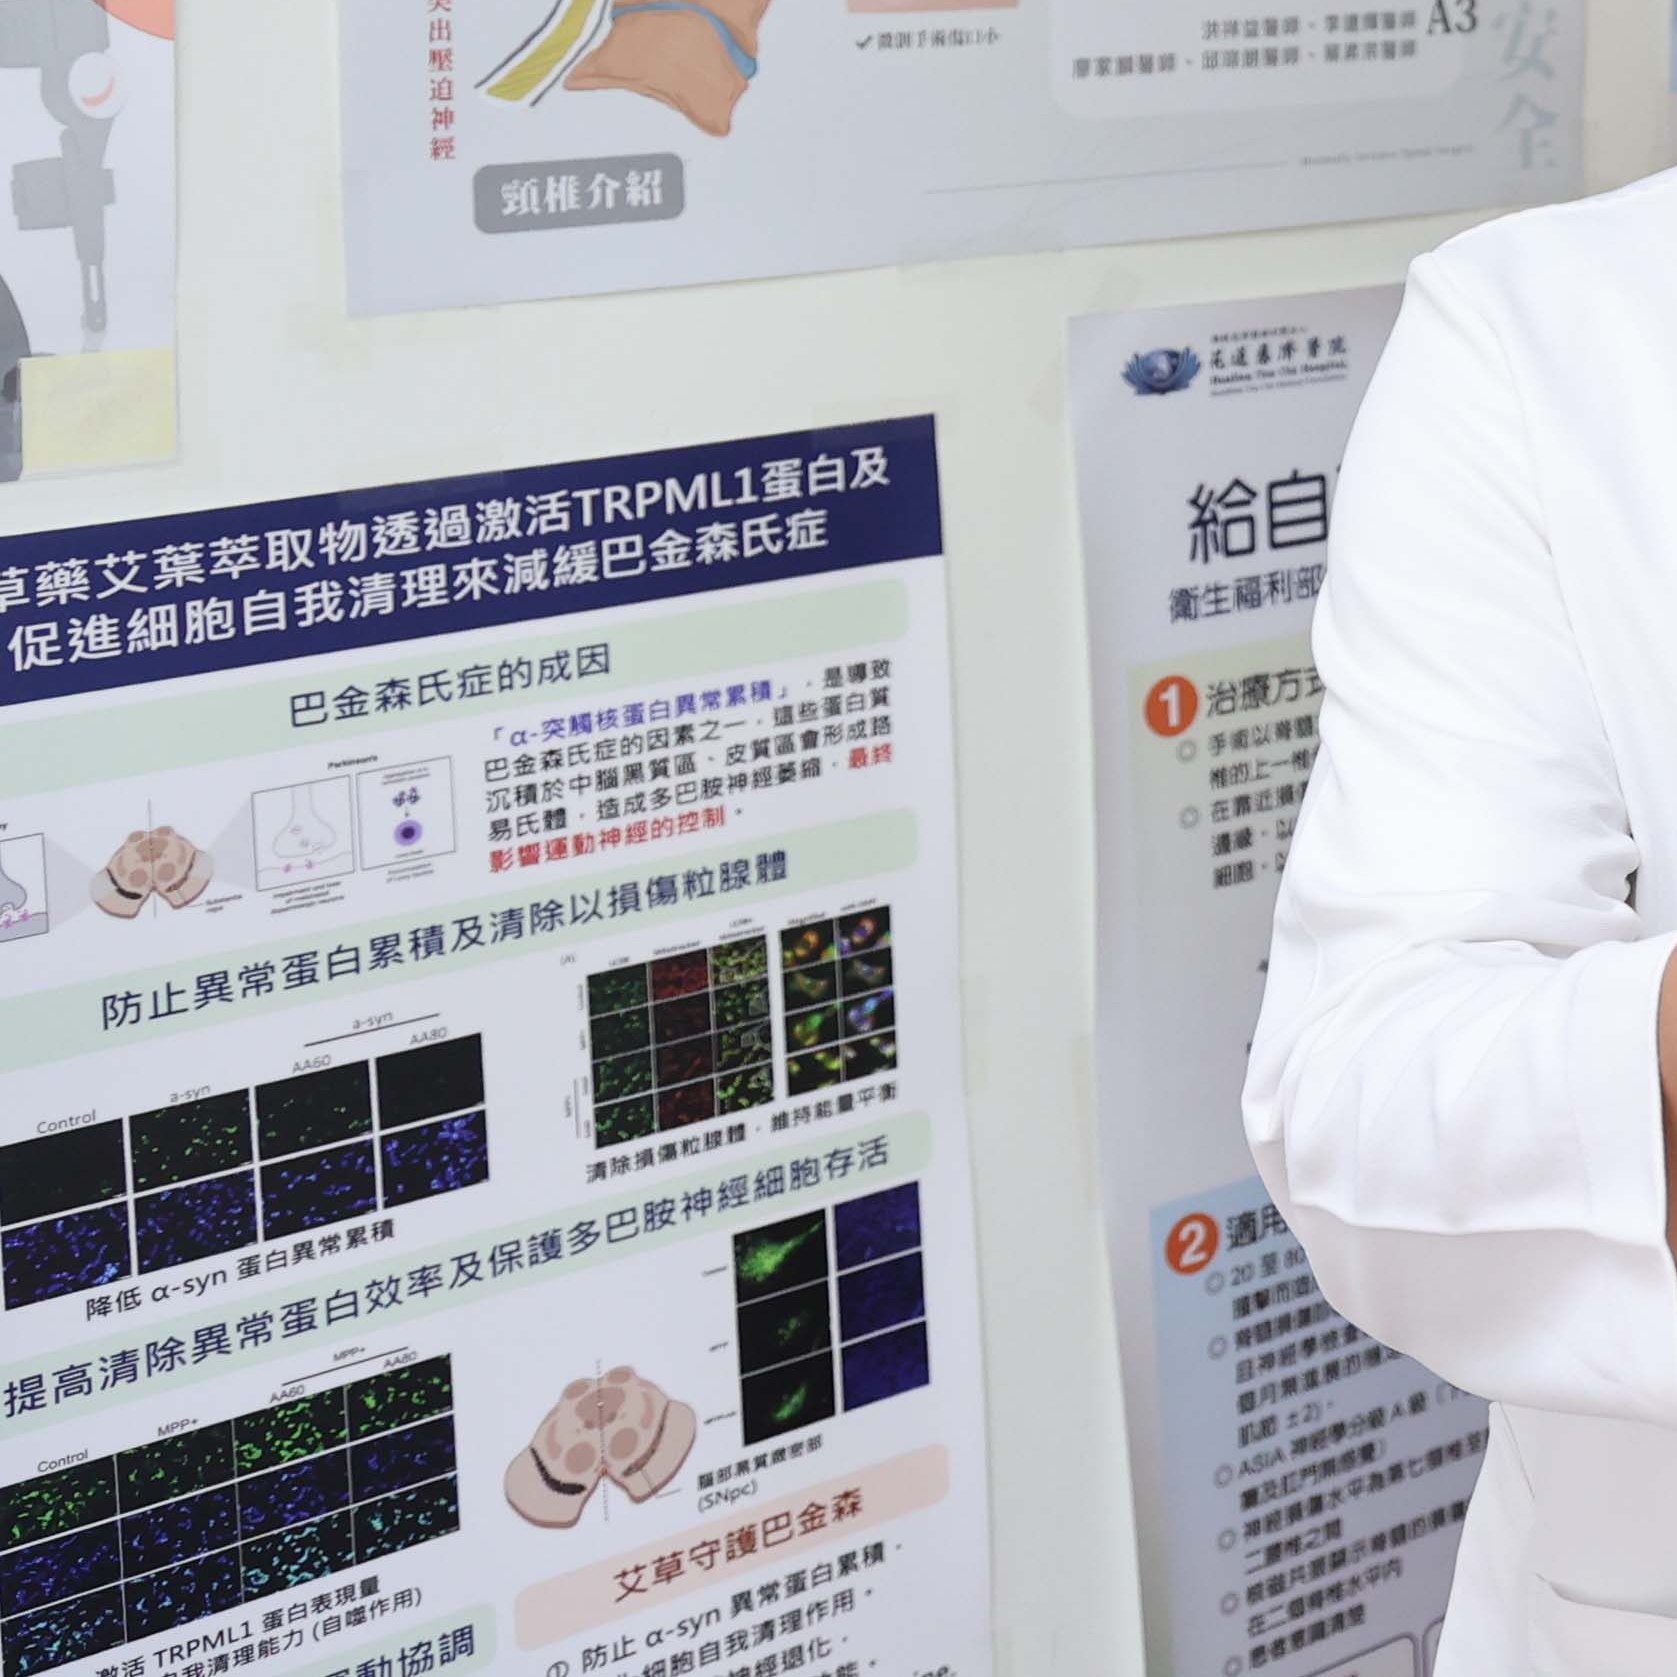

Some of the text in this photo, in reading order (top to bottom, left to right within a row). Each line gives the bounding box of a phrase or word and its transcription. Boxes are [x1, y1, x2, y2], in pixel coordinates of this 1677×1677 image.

[502, 170, 663, 216] 頸椎介紹
[0, 446, 892, 614] 草藥艾葉萃取物透過激活TRPML1蛋白及
[1187, 468, 1340, 565] 給自
[8, 509, 829, 672] 促進細胞自我清理來減緩巴金森氏症
[290, 643, 611, 728] 巴金森氏症的成因
[1159, 684, 1181, 728] 1
[102, 849, 788, 1031] 防止異常蛋白累積及清除以損傷粒腺體
[36, 1108, 97, 1135] Control
[3, 1134, 890, 1419] 提高清除異常蛋白效率及保護多巴胺神經細胞存活
[86, 1285, 142, 1321] 降低
[236, 1218, 396, 1277] 蛋白異常累積
[1179, 1221, 1207, 1268] 2
[36, 1448, 89, 1474] Control
[698, 1479, 759, 1514] (SNpc)
[612, 1488, 864, 1605] 艾草守護巴金森
[153, 1622, 252, 1669] TRPML1
[262, 1574, 381, 1632] 蛋白表現量
[324, 1623, 475, 1677] 動協調
[582, 1636, 637, 1675] 防止
